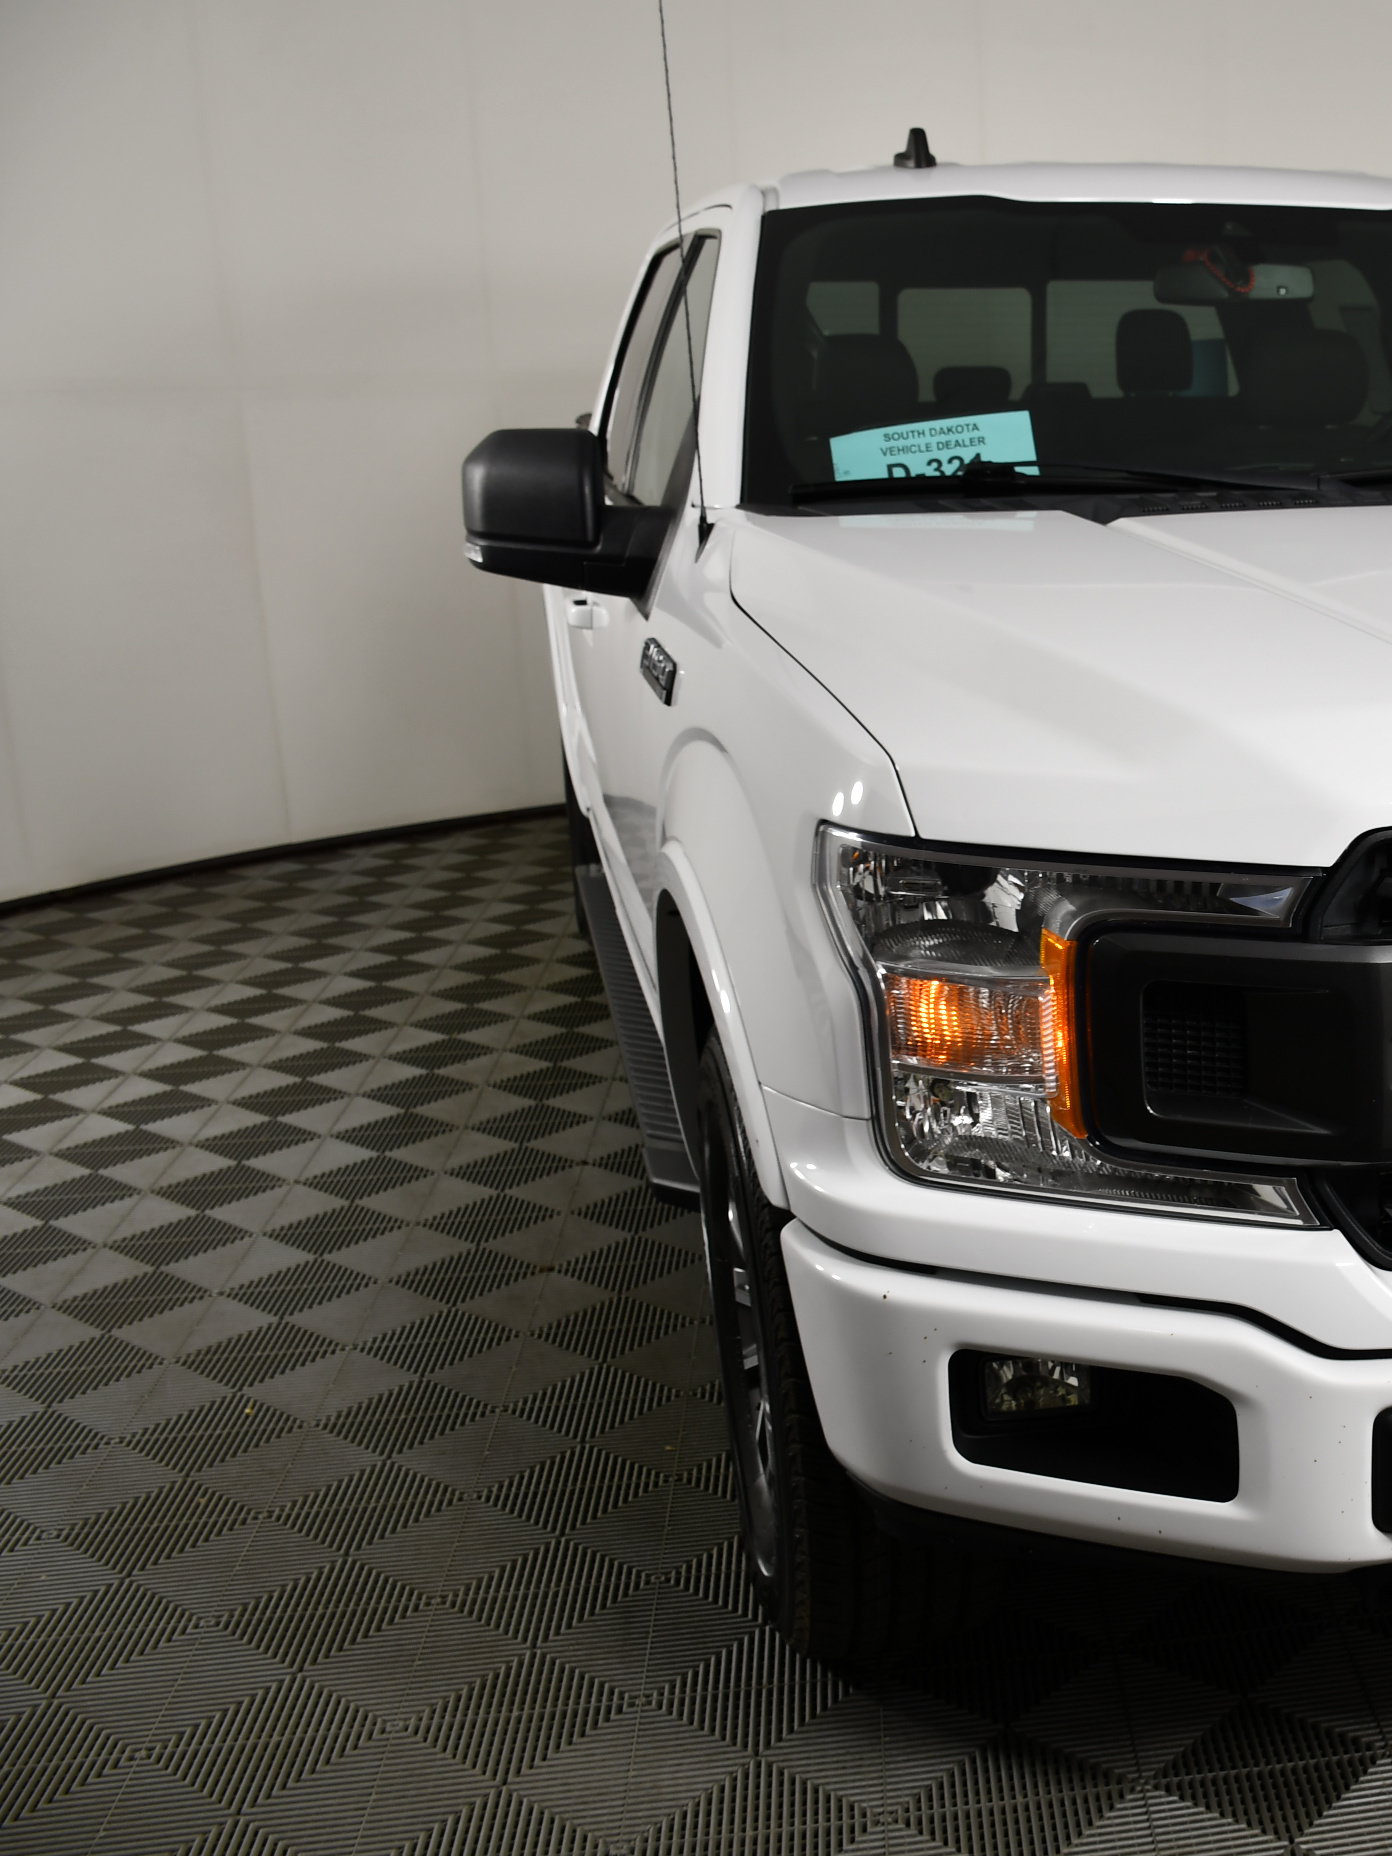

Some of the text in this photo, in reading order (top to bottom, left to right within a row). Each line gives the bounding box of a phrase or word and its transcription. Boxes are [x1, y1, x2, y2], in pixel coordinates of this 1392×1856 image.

[883, 423, 980, 442] SOUTH DAKOTA
[880, 436, 986, 456] VEHICLE DEALER
